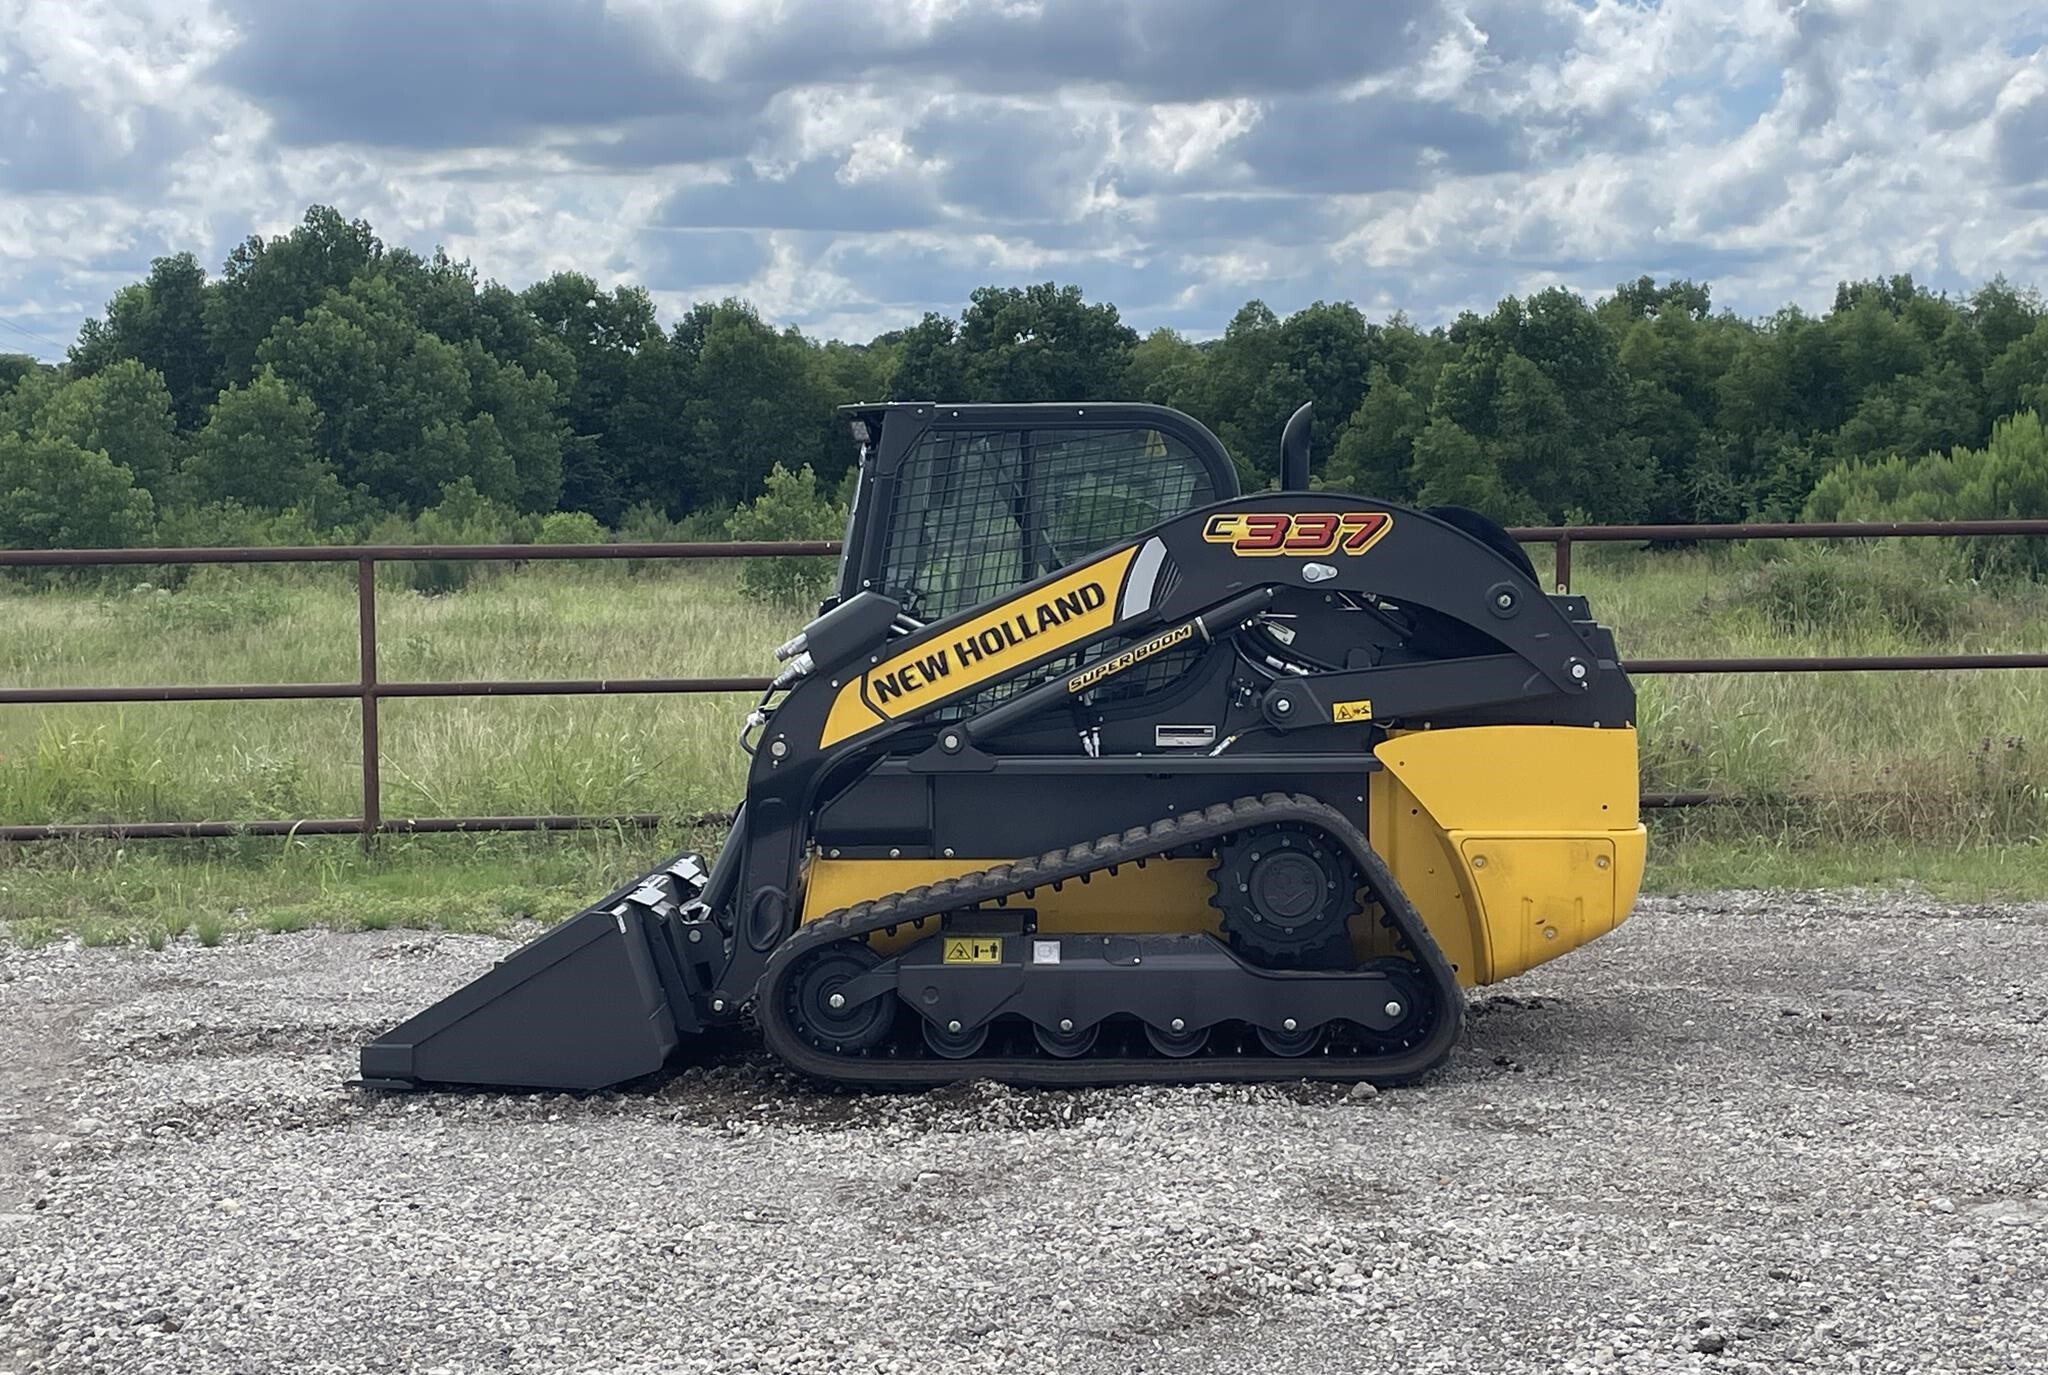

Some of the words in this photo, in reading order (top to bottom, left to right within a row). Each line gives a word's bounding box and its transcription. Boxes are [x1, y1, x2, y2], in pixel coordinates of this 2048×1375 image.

[1204, 514, 1391, 554] C337
[872, 649, 950, 704] NEW
[953, 582, 1106, 668] HOLLAND
[1070, 653, 1132, 691] SUPER
[1135, 625, 1191, 660] BOOM
